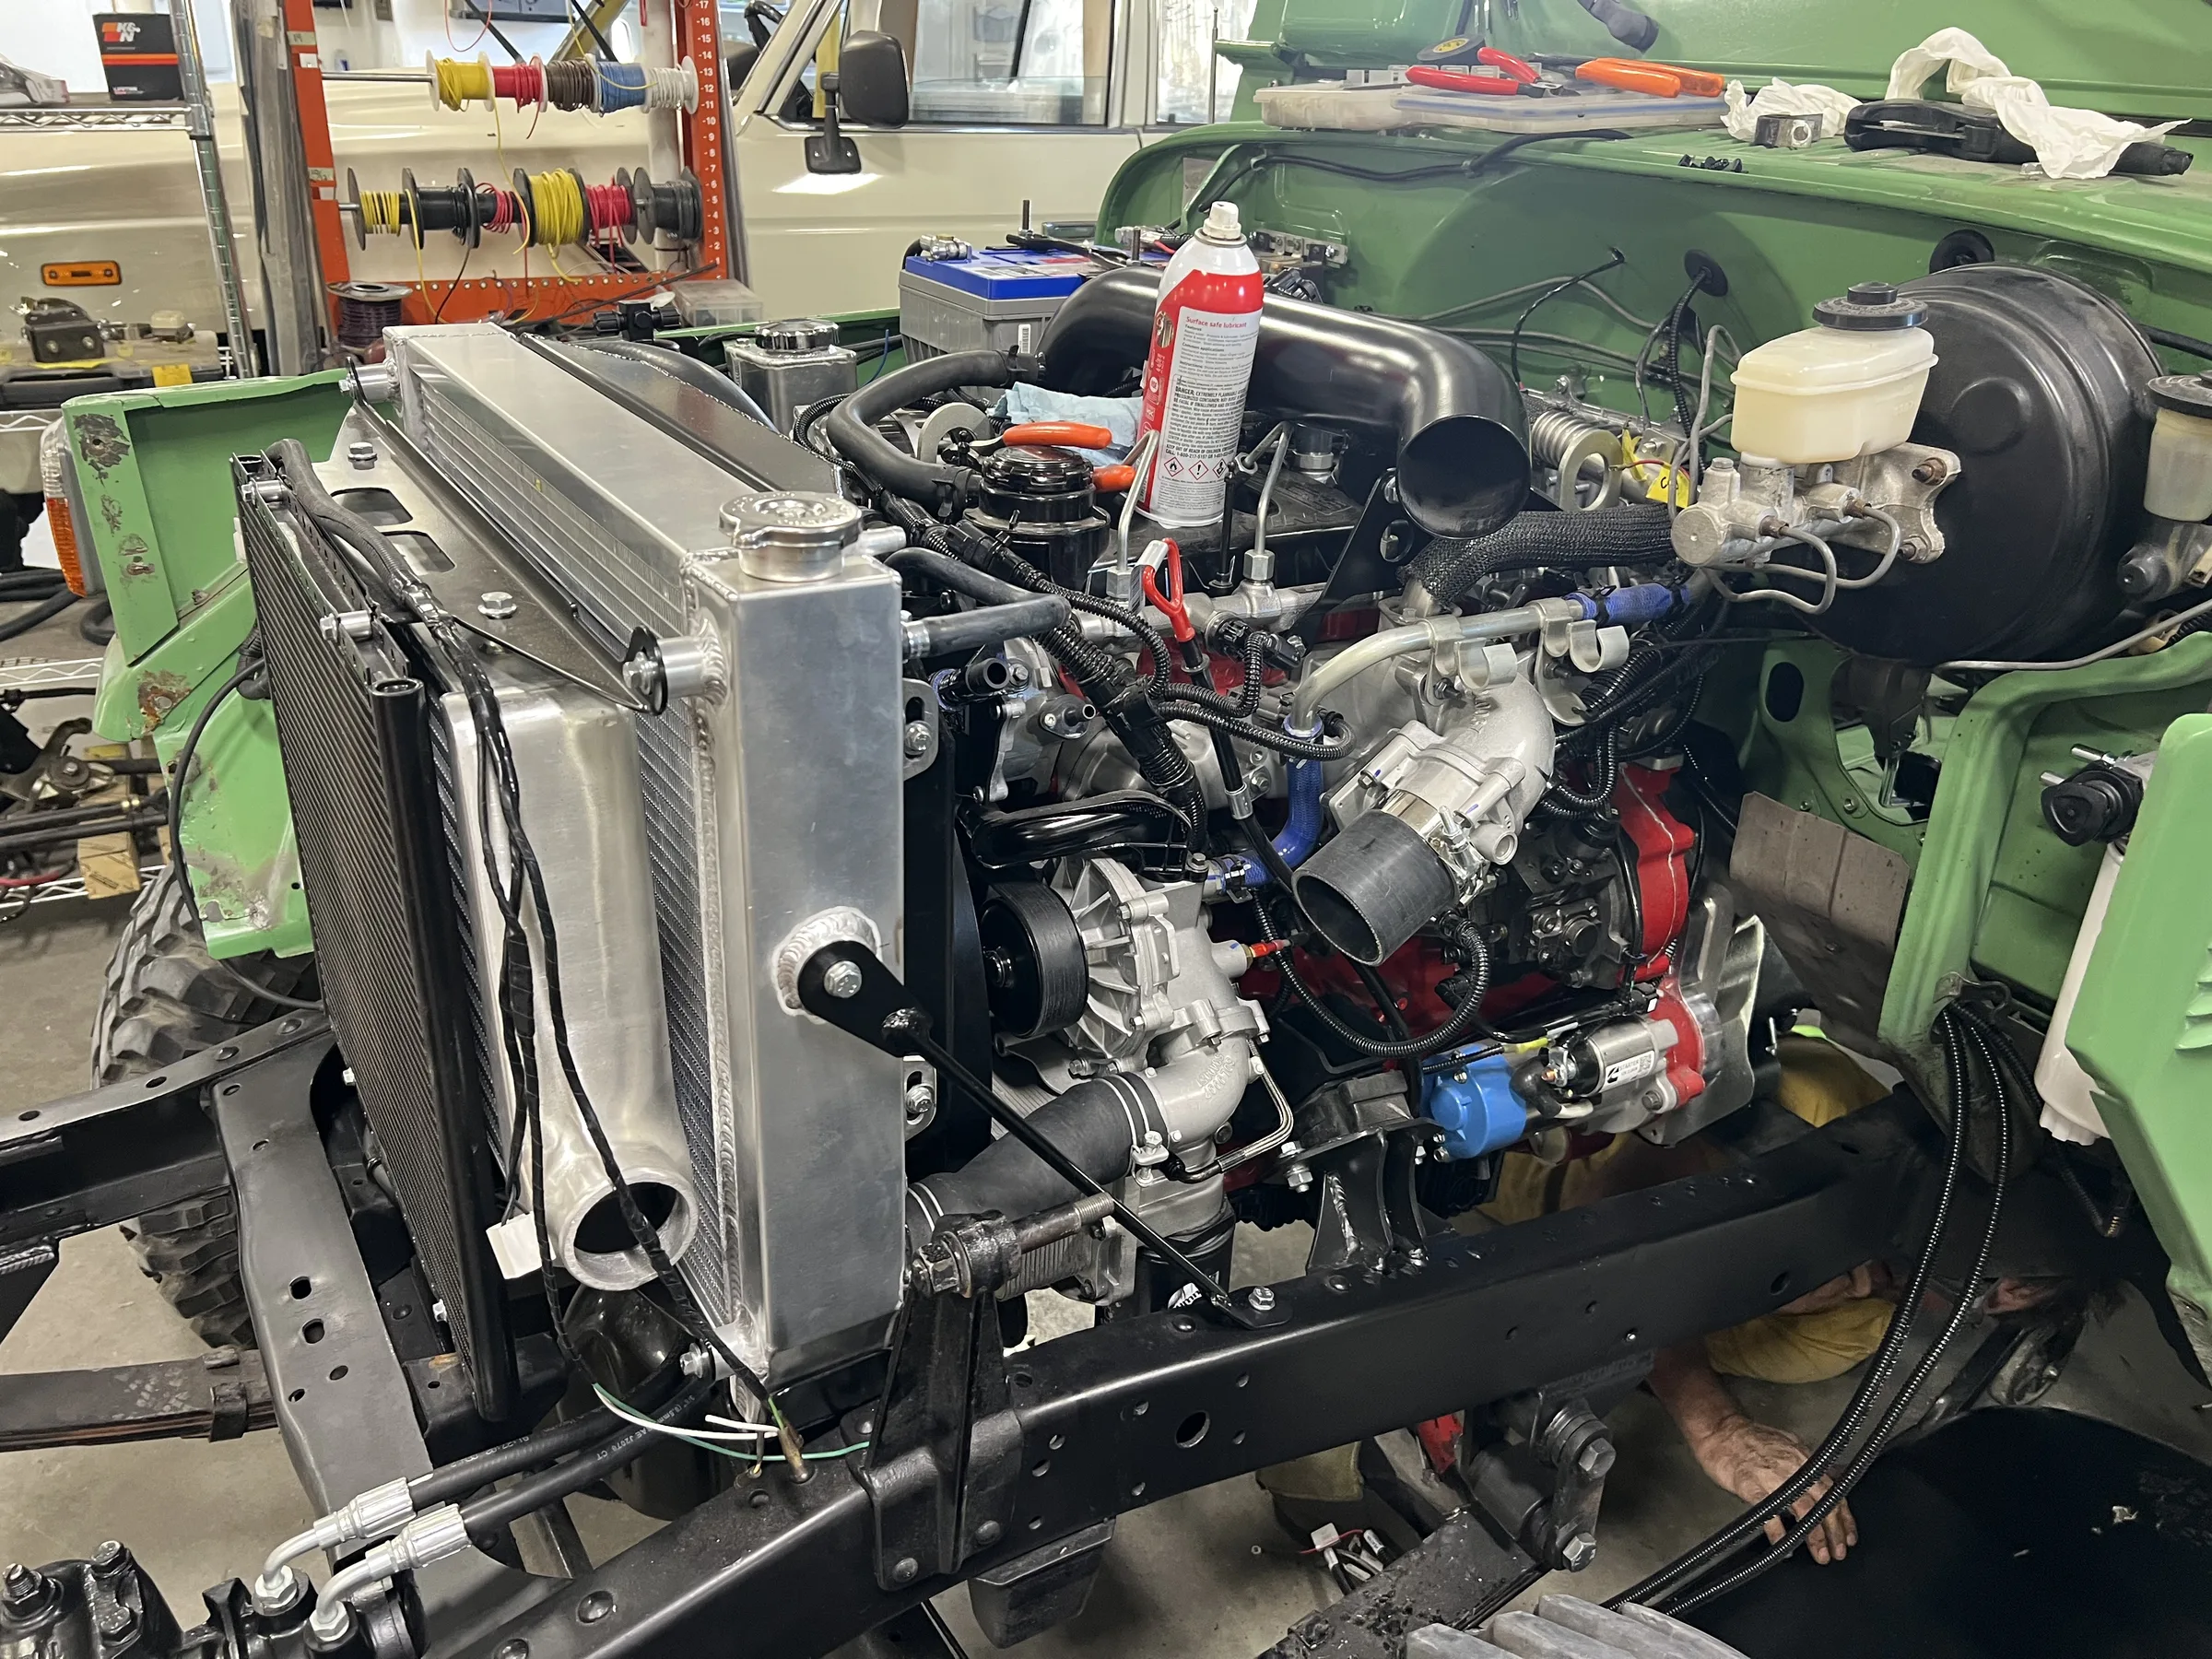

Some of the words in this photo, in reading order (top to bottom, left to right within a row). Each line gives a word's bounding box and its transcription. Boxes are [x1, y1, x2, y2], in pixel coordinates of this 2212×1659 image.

[1186, 316, 1208, 326] Surface
[1174, 393, 1198, 401] PRESSURIZED
[596, 1450, 608, 1461] CT
